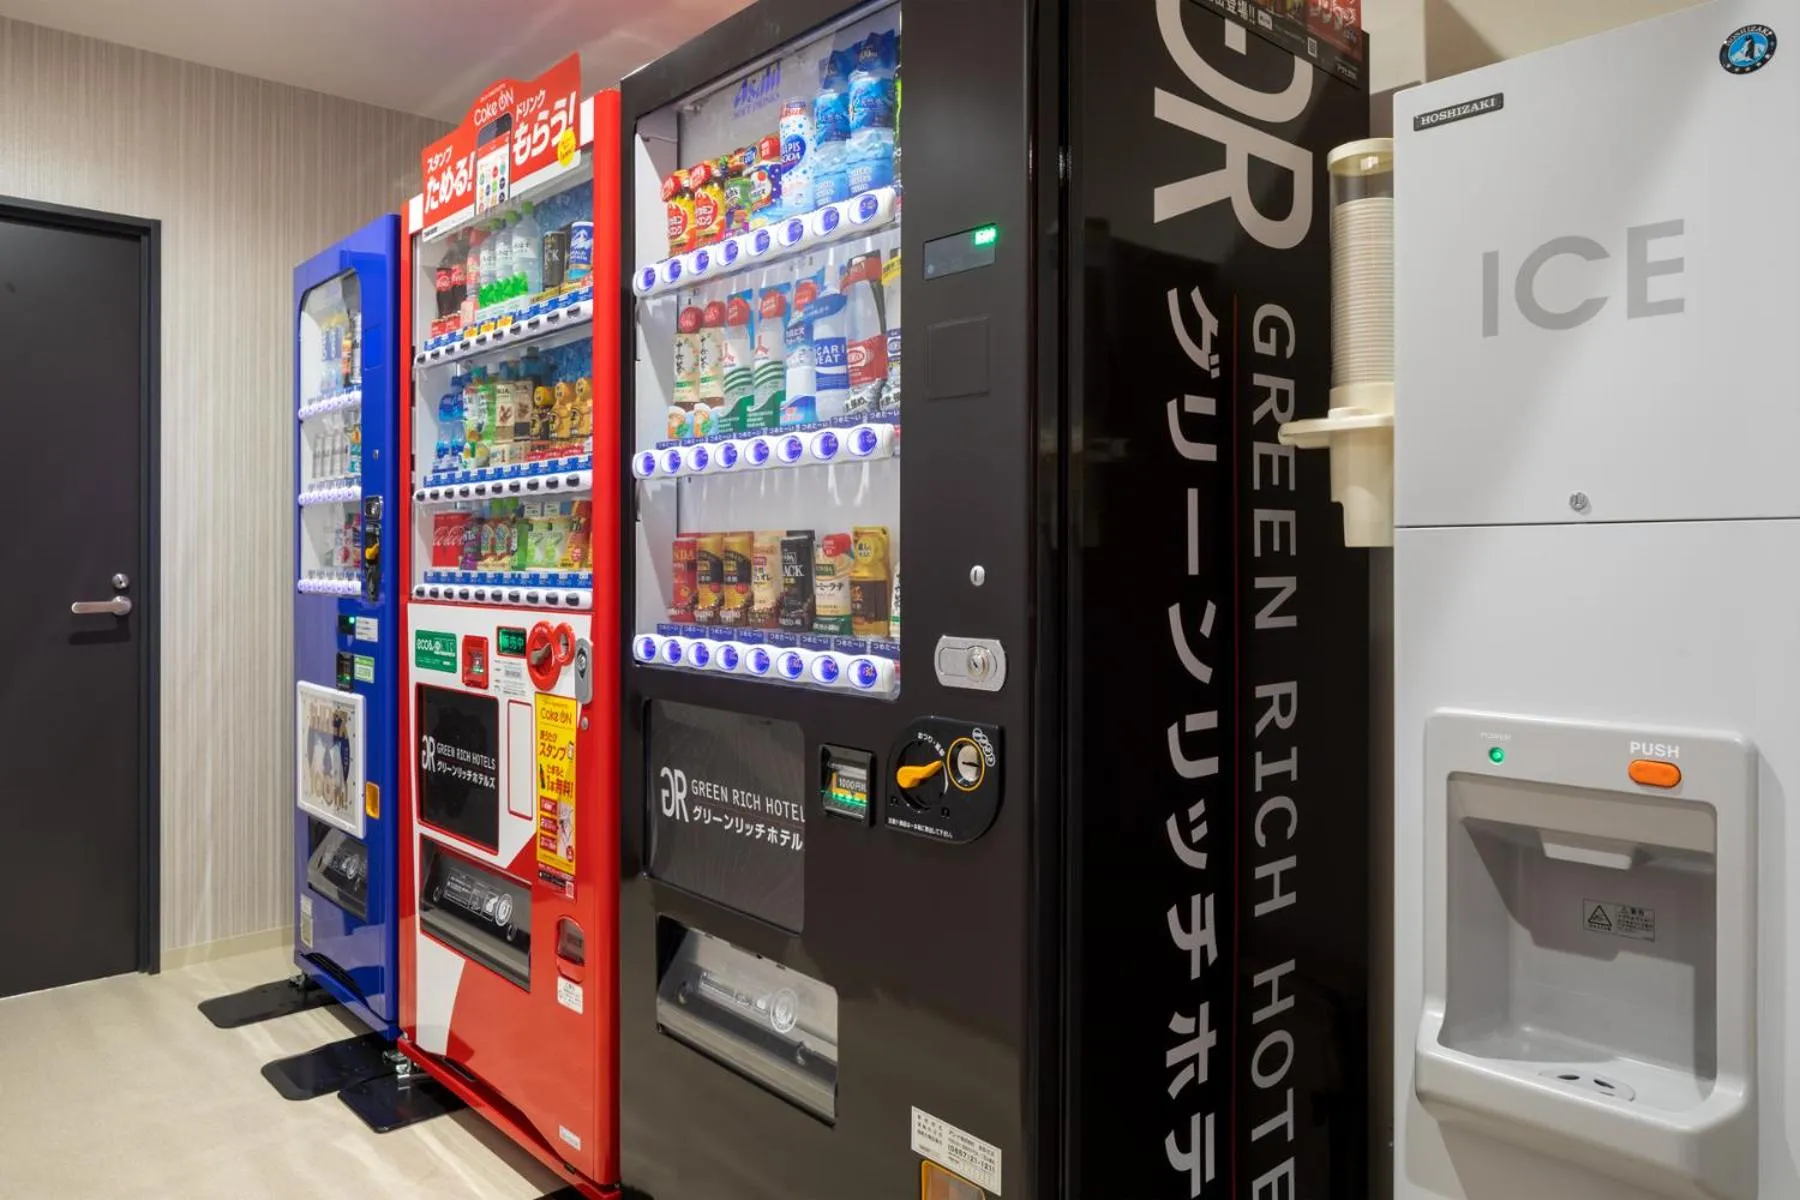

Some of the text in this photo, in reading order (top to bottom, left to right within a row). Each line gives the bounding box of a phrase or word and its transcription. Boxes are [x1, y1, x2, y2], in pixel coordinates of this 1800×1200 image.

[474, 102, 497, 126] Coke
[516, 88, 546, 122] ドリンク
[1421, 98, 1496, 125] HOSHIZAKI
[427, 145, 453, 174] スタンプ
[1482, 219, 1685, 338] ICE
[1253, 303, 1297, 630] GREEN
[541, 708, 558, 722] Coke
[437, 742, 496, 770] GREEN RICH HOTELS
[1630, 741, 1680, 758] PUSH
[437, 760, 496, 790] グリーンリッチホテルズ
[691, 779, 806, 823] GREEN RICH HOTEL
[1254, 681, 1298, 918] RICH
[692, 805, 803, 851] グリーンリッチホテル
